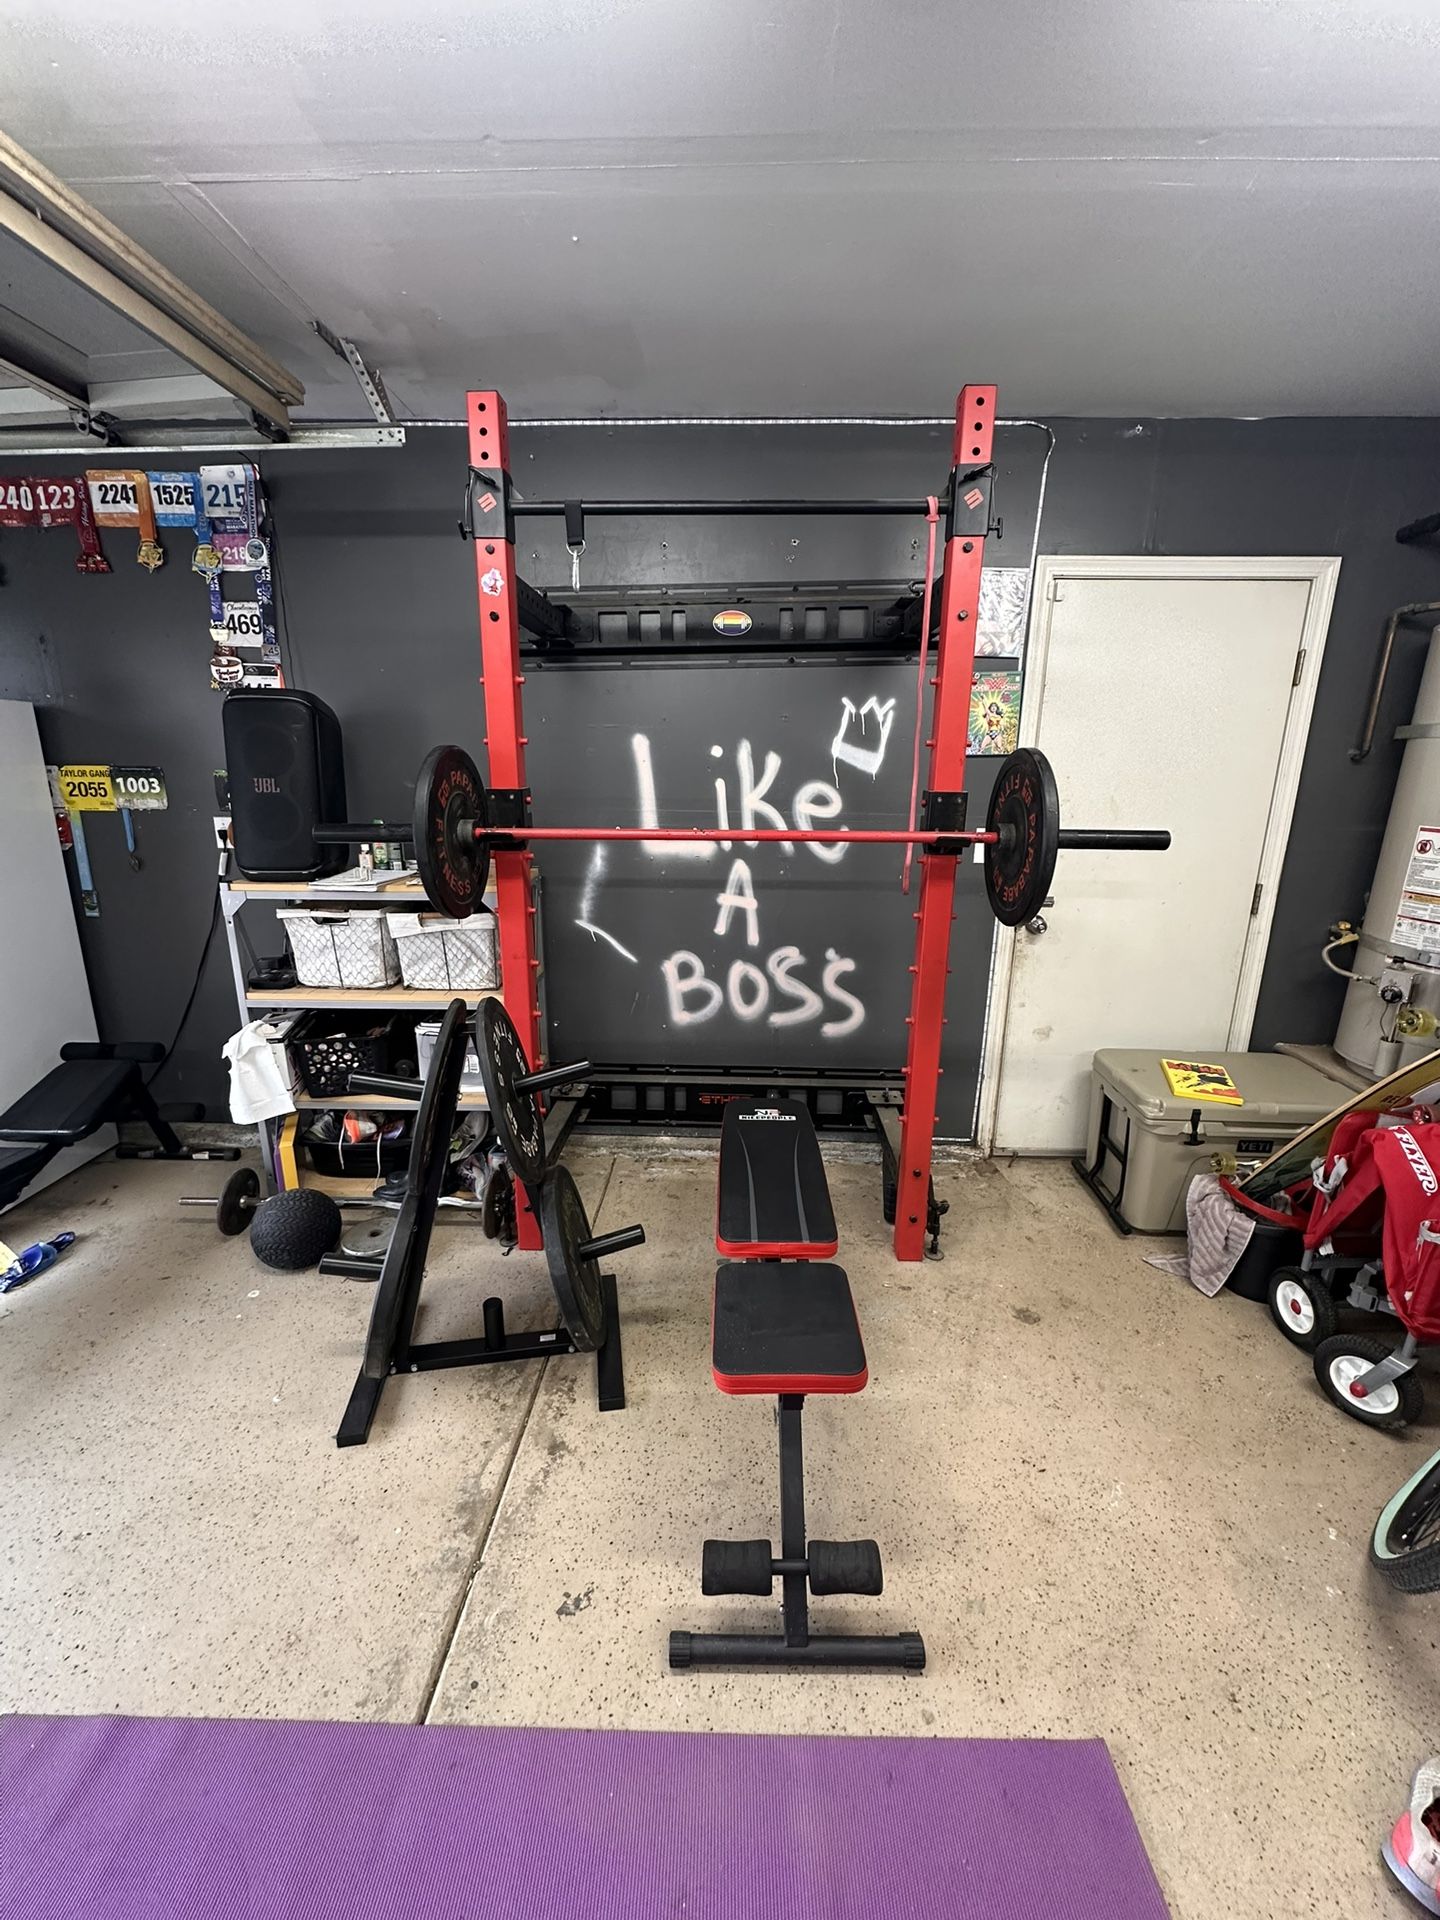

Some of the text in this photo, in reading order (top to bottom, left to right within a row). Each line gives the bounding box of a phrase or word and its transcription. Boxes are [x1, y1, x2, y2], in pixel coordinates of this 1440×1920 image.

[36, 486, 75, 510] 123
[98, 484, 138, 504] 2241
[154, 485, 194, 505] 1525
[207, 484, 246, 508] 215
[226, 613, 263, 635] 469
[60, 769, 110, 778] TAYLOR GANG
[66, 782, 107, 797] 2055
[116, 777, 161, 793] 1003
[253, 777, 280, 793] JBL
[435, 817, 472, 897] FITNESS
[713, 857, 760, 947] A
[661, 944, 866, 1038] BOSS
[1239, 1142, 1271, 1151] YETI
[1394, 1127, 1438, 1194] FLYER
